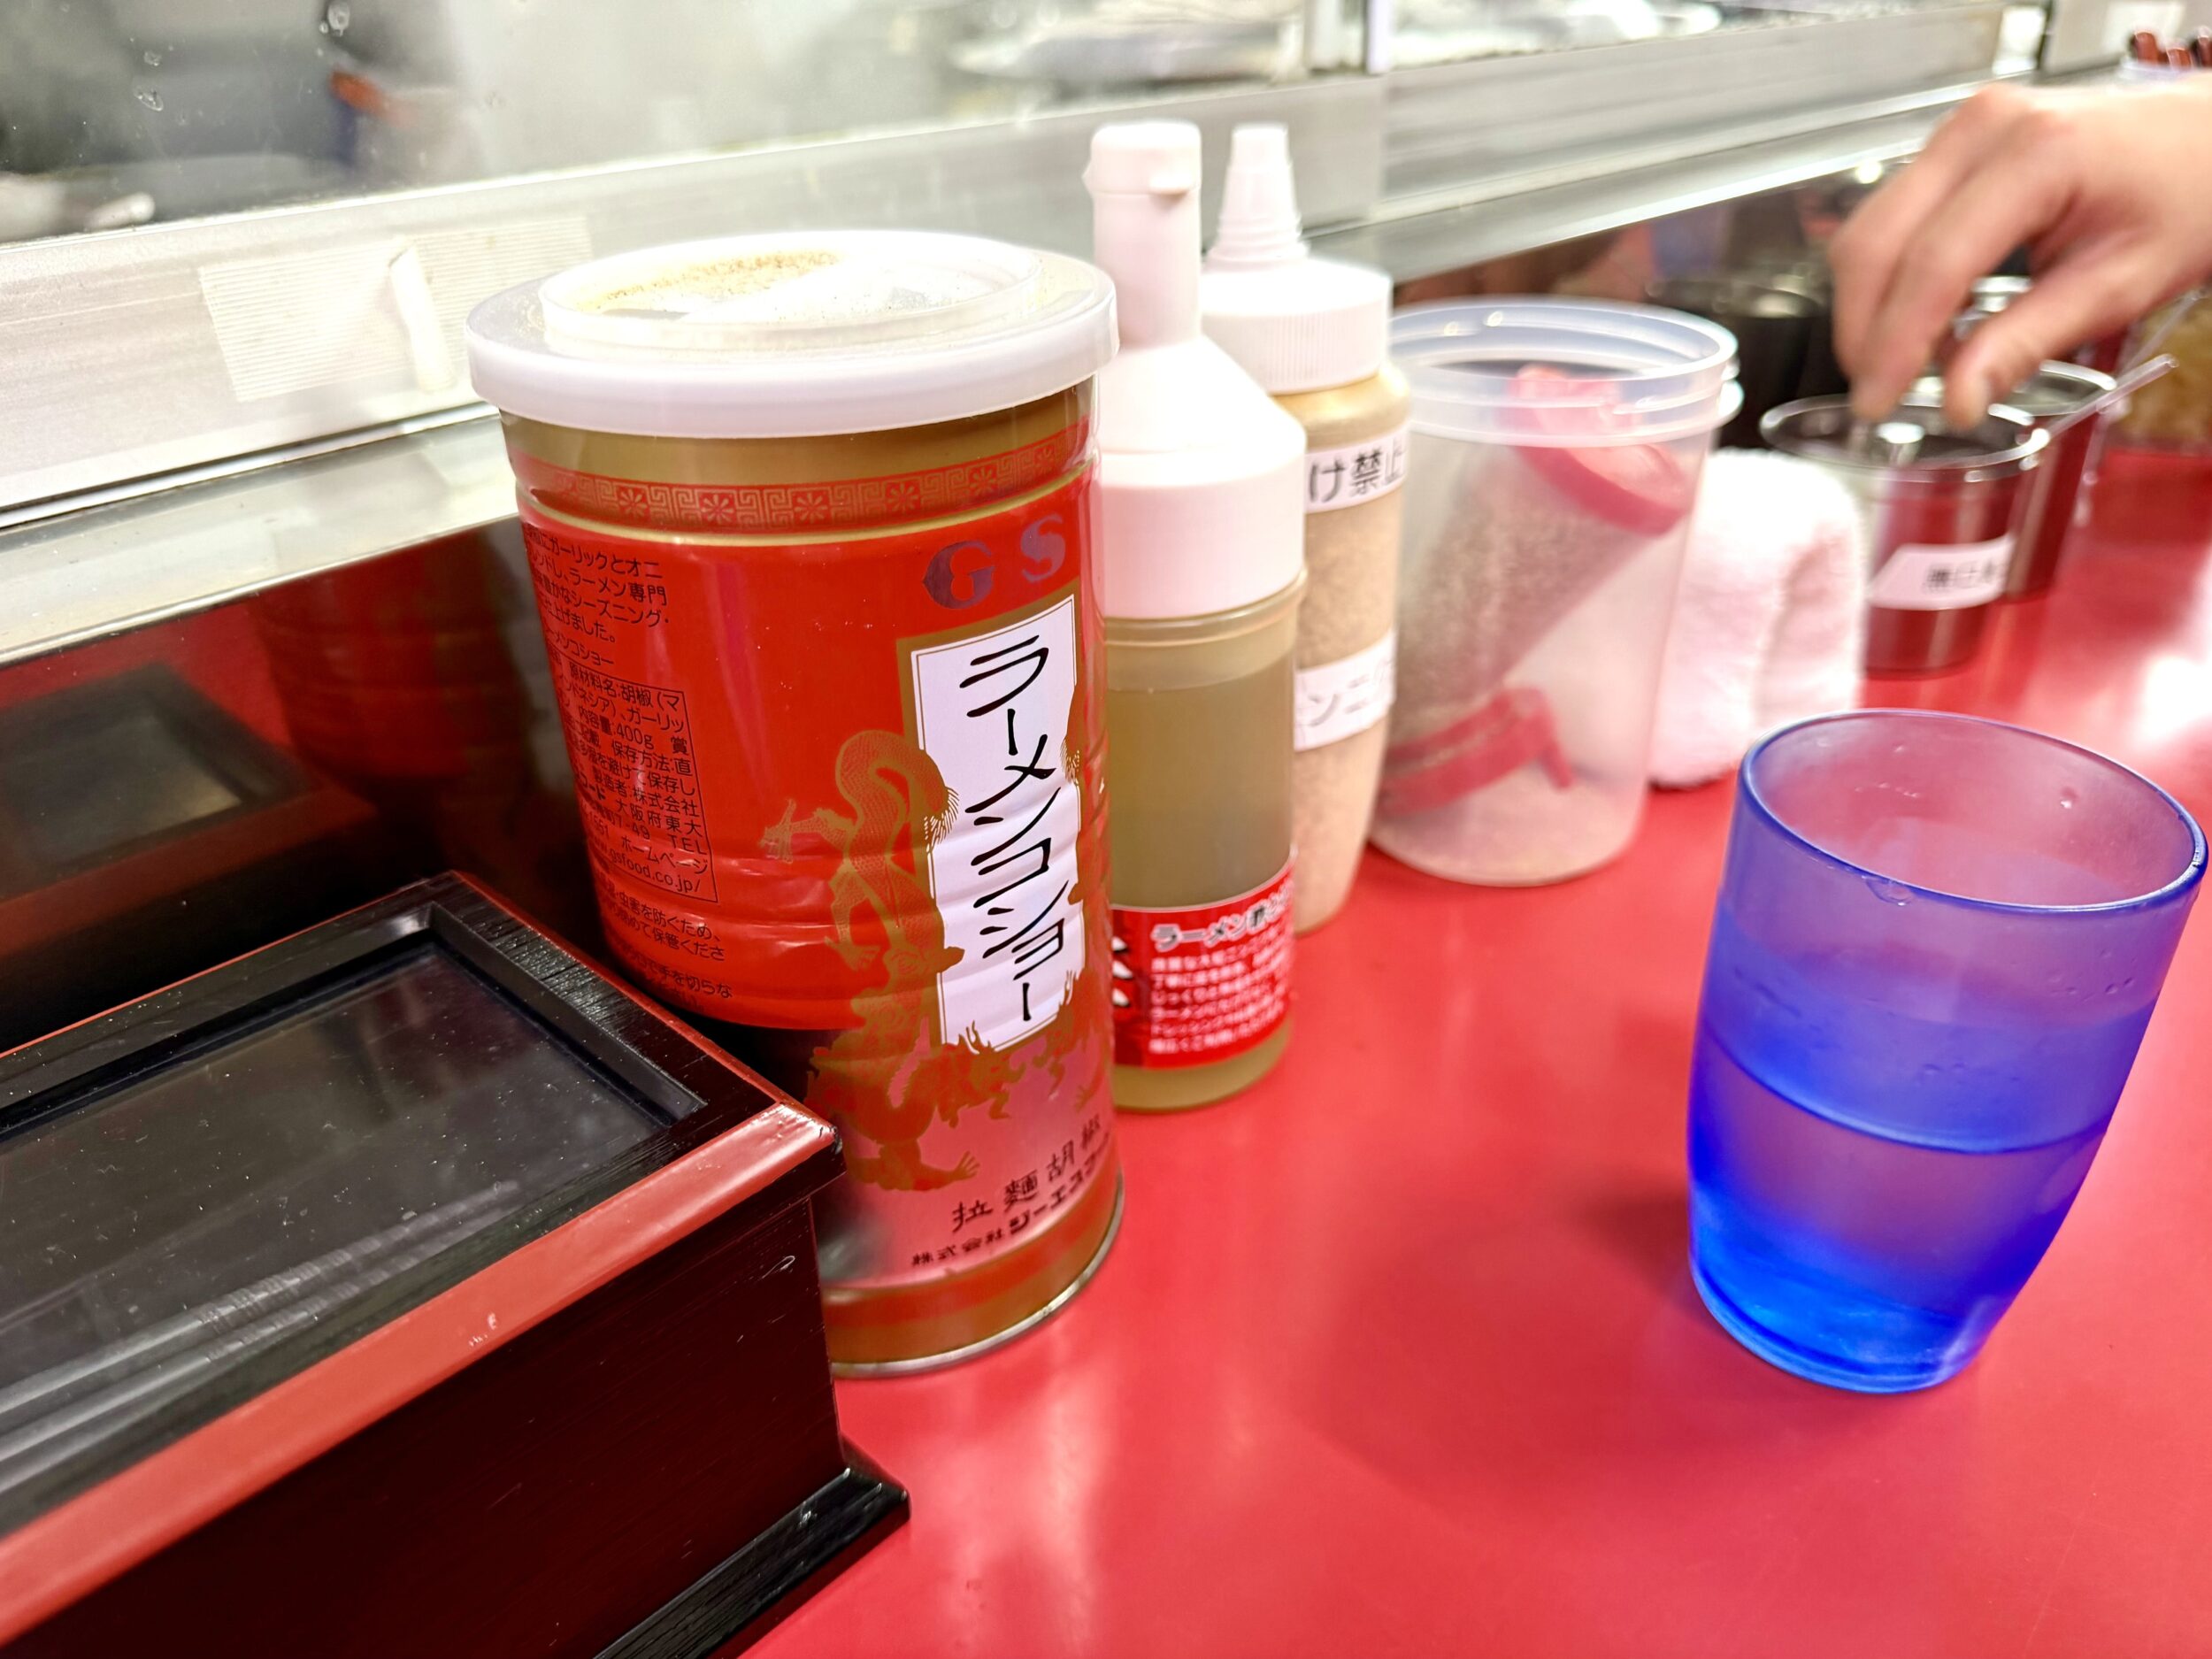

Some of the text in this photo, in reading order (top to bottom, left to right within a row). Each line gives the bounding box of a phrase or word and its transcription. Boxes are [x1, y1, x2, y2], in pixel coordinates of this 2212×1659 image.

[546, 626, 614, 666] ーメンコショー
[959, 634, 1069, 1022] ラーメンコショー
